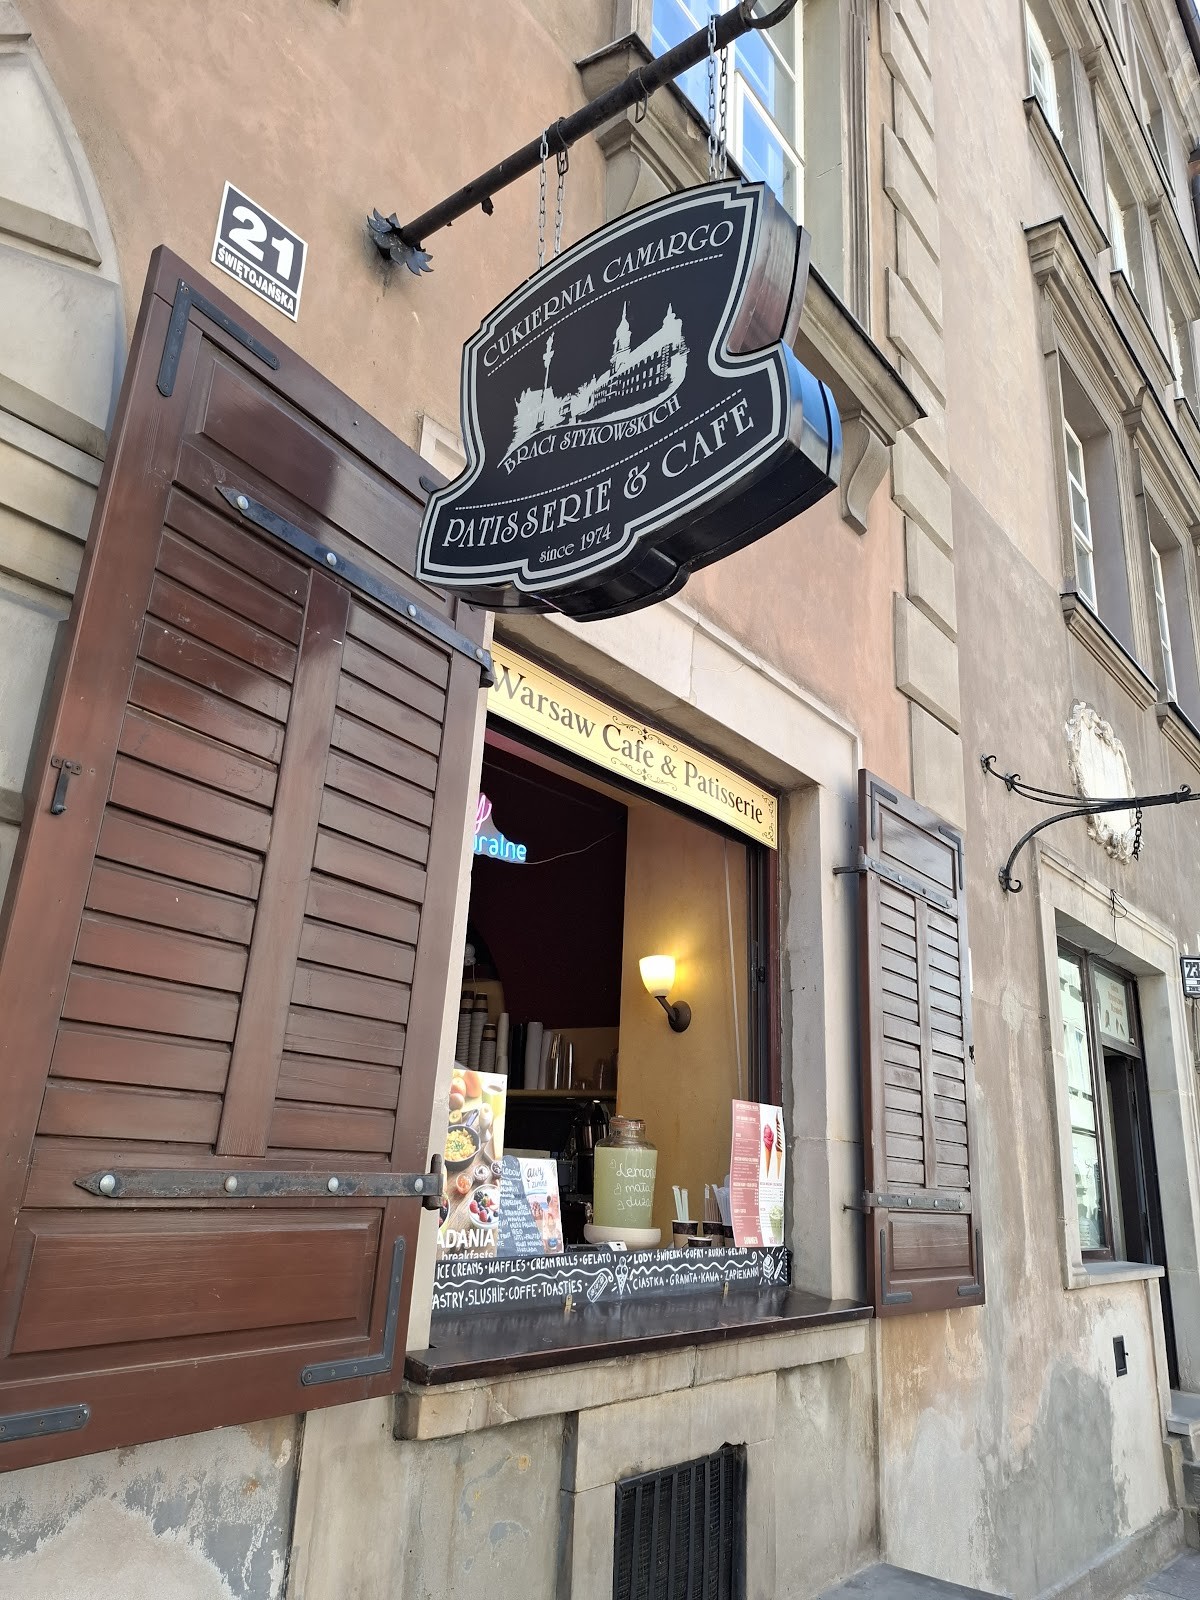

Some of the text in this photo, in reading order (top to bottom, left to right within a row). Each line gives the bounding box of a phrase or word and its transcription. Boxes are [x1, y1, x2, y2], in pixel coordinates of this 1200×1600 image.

[228, 205, 294, 280] 21
[217, 246, 294, 312] ŚWIĘTOJAŃSKA
[482, 220, 734, 367] CUKIERNIA CAMARGO
[504, 394, 681, 475] BRACI STYKOWSKICH
[442, 399, 754, 548] PATISSERIE & CAFE
[538, 525, 612, 564] since 1974
[490, 660, 764, 824] Warsaw Cafe & Patisserie
[441, 1250, 495, 1261] breakfasts
[488, 1258, 525, 1275] WAFFLES
[556, 1254, 578, 1268] ROLLS
[582, 1252, 611, 1266] GELATO
[633, 1251, 653, 1265] LODY
[700, 1271, 720, 1284] KAWA
[508, 1283, 537, 1301] COFFE
